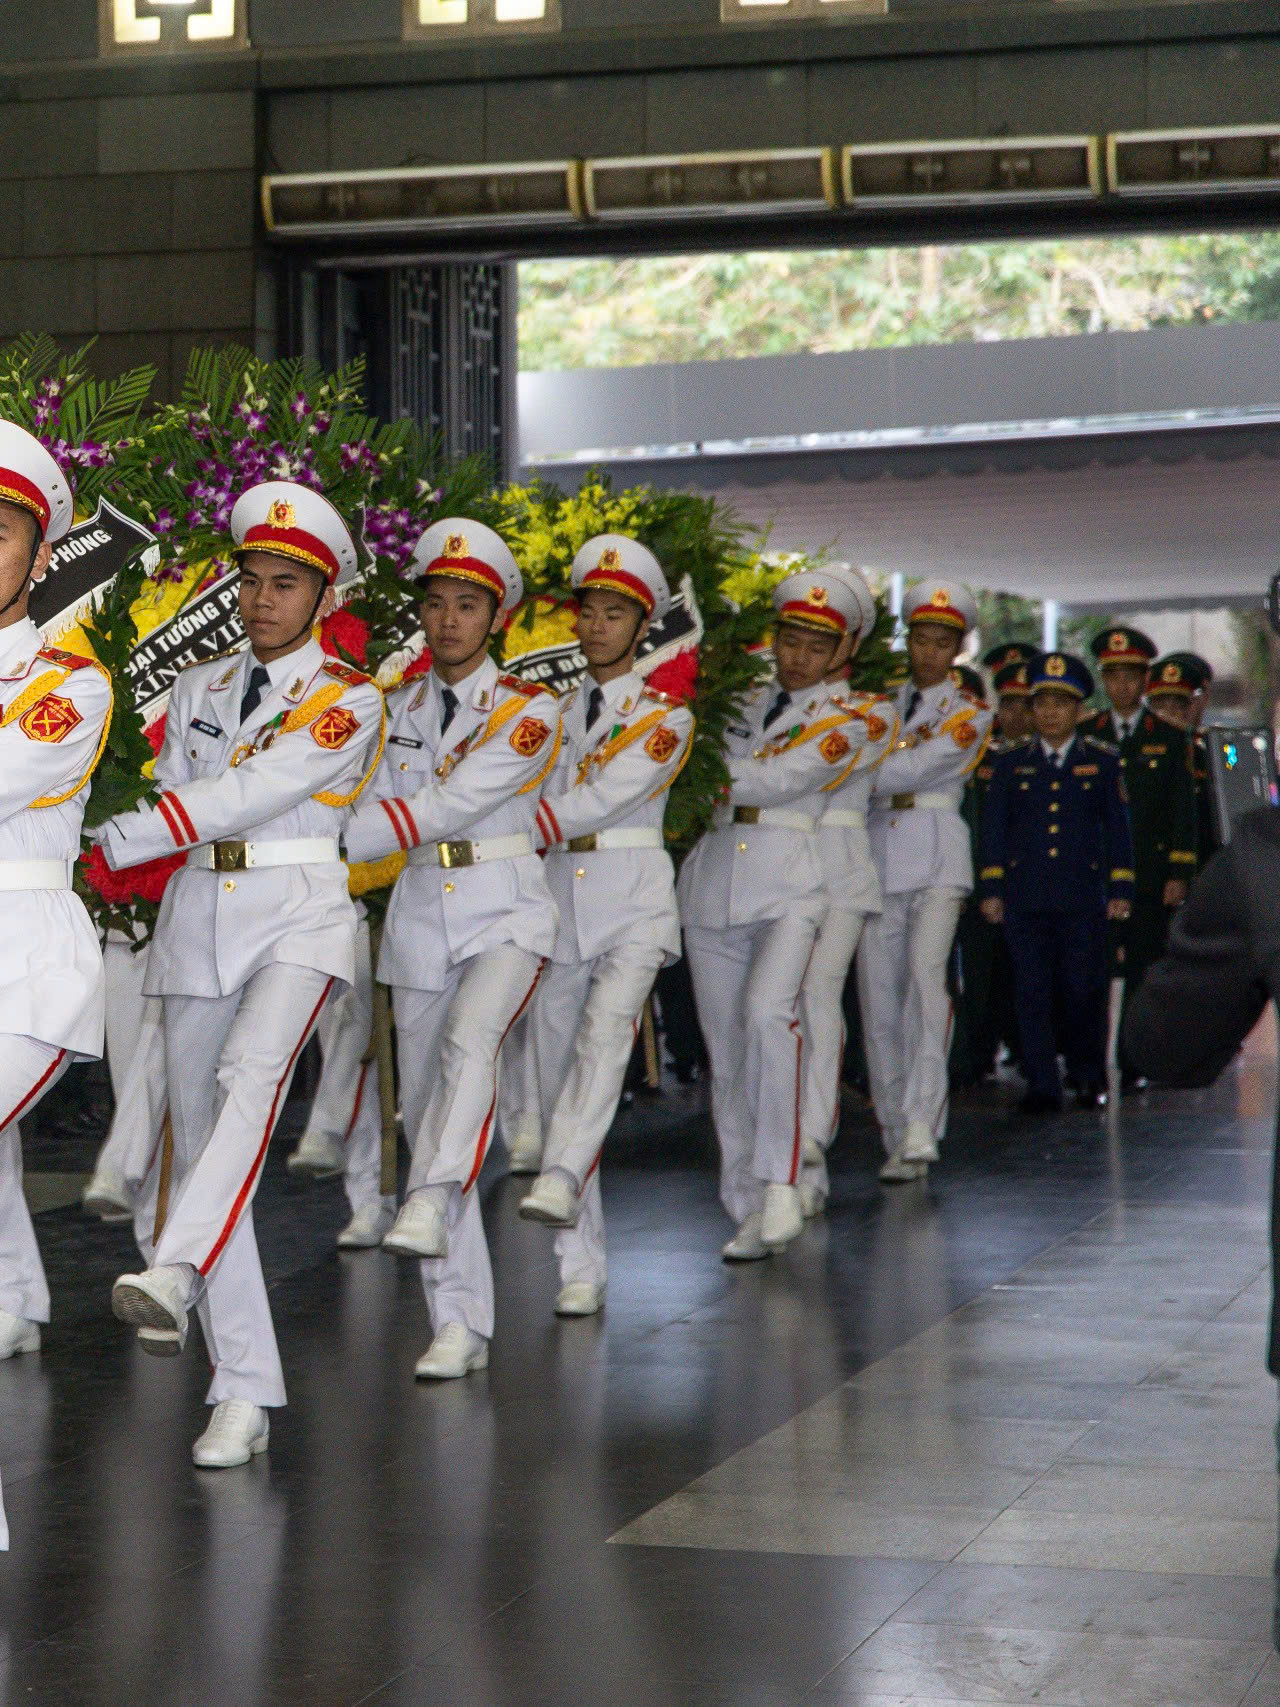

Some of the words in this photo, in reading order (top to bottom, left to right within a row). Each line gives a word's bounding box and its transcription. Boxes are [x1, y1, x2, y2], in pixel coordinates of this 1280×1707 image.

[49, 529, 112, 571] PHÒNG
[155, 602, 220, 652] TƯỚNG
[131, 648, 198, 705] KÍNH
